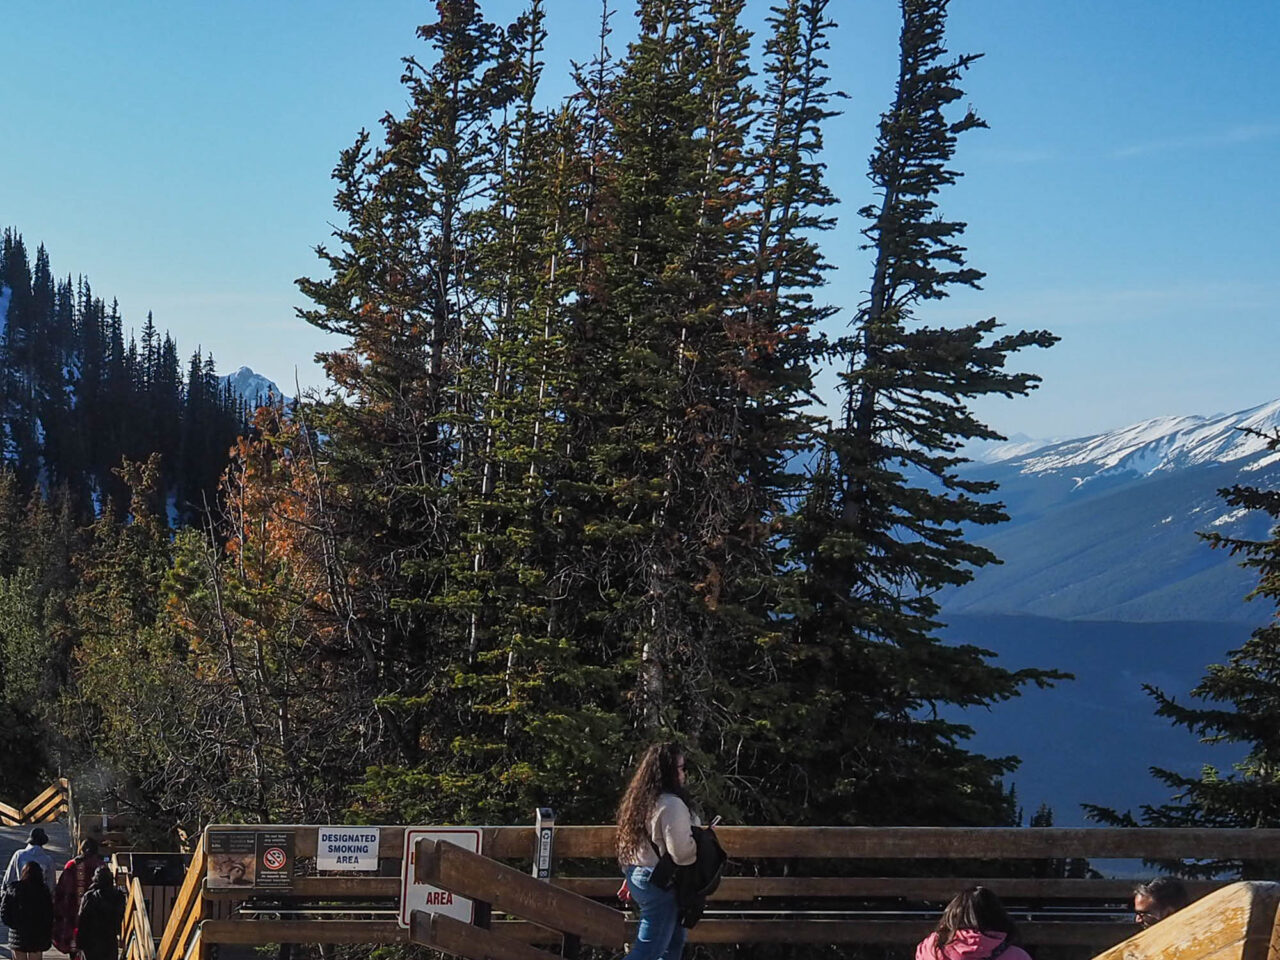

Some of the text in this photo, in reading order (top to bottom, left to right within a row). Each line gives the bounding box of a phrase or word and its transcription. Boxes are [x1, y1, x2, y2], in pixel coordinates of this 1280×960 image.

[322, 834, 376, 844] DESIGNATED
[328, 844, 369, 854] SMOKING
[336, 854, 360, 864] AREA
[426, 892, 453, 905] AREA
